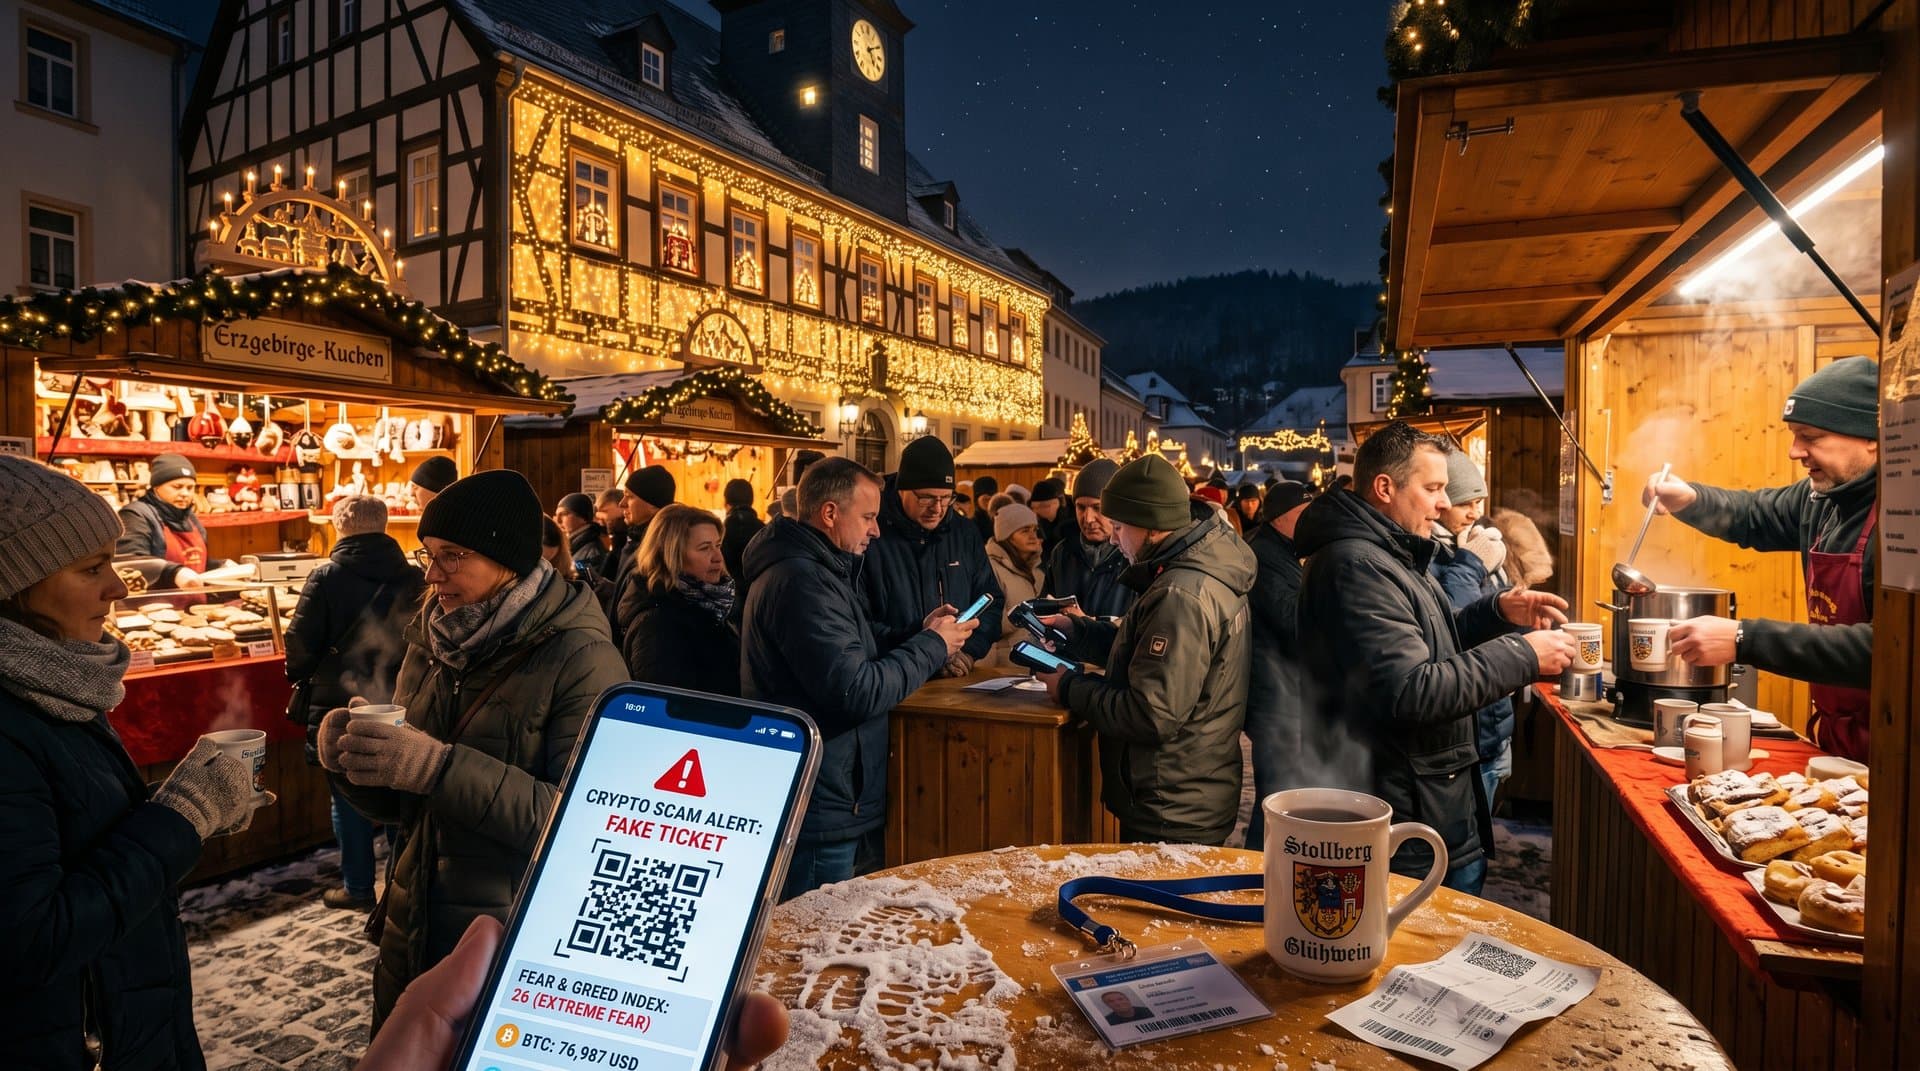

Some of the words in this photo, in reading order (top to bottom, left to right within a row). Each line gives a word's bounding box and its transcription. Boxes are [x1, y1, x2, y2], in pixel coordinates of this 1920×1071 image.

[214, 324, 384, 367] Erzgebirge-Kuchen
[586, 788, 650, 814] CRYPTO
[653, 801, 702, 823] SCAM
[704, 811, 763, 835] ALERT:
[605, 814, 655, 839] FAKE
[659, 824, 728, 852] TICKET
[1284, 835, 1373, 862] Stollberg
[1284, 936, 1371, 965] Glühwein
[511, 988, 529, 1004] 26
[533, 992, 606, 1021] (EXTREME
[608, 1010, 651, 1034] FEAR)
[518, 968, 555, 989] FEAR
[557, 977, 569, 992] &
[572, 981, 618, 1002] GREED
[621, 991, 670, 1014] INDEX:
[522, 1033, 555, 1053] BTC:
[560, 1041, 607, 1064] 76,987
[609, 1053, 639, 1071] USD
